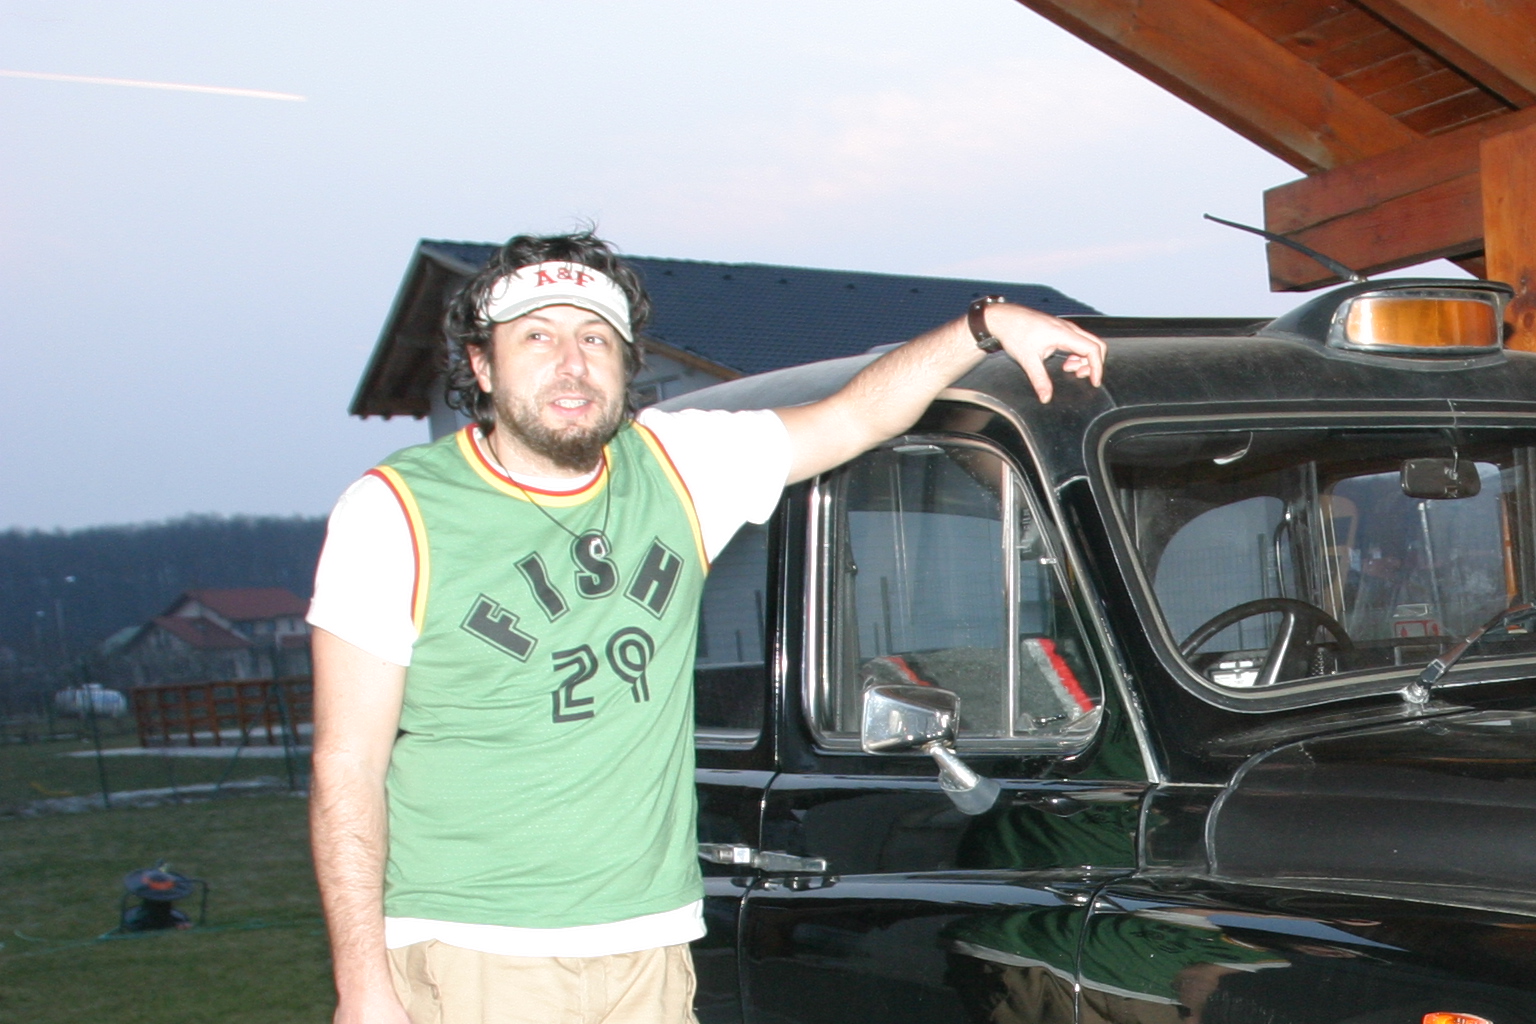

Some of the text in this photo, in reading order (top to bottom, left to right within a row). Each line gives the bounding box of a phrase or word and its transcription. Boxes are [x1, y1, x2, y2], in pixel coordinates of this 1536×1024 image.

[533, 266, 595, 288] A&F
[460, 529, 684, 663] FISH
[552, 627, 656, 724] 29
